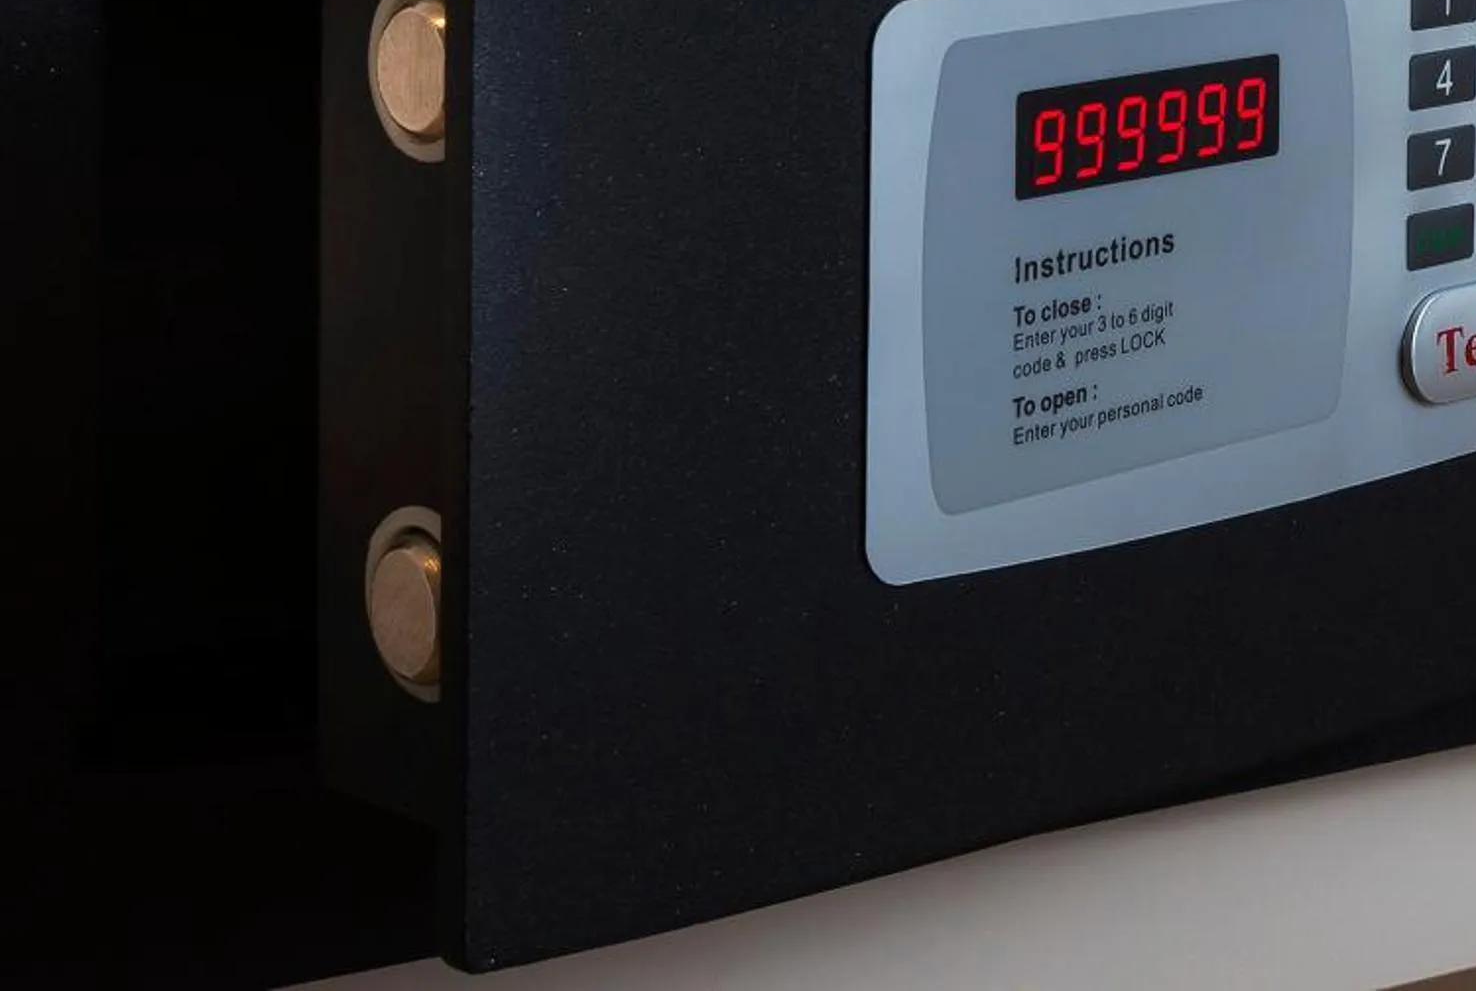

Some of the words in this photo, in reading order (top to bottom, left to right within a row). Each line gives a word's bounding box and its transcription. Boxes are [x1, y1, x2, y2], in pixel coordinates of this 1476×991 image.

[1435, 59, 1453, 96] 4
[1034, 77, 1268, 186] 999999
[1435, 138, 1452, 176] 7
[1014, 232, 1175, 284] Instructions
[1013, 305, 1036, 328] To
[1013, 330, 1056, 351] Enter
[1060, 320, 1094, 346] your
[1097, 315, 1107, 333] 3
[1111, 315, 1125, 330] to
[1128, 308, 1138, 325] 6
[1141, 302, 1174, 325] digit
[1013, 356, 1051, 379] code
[1056, 351, 1066, 369] &
[1075, 342, 1117, 368] press
[1121, 328, 1167, 354] LOCK
[1013, 396, 1036, 419] To
[1013, 424, 1056, 446] Enter
[1060, 413, 1094, 439] your
[1097, 393, 1164, 428] personal
[1167, 385, 1204, 408] code
